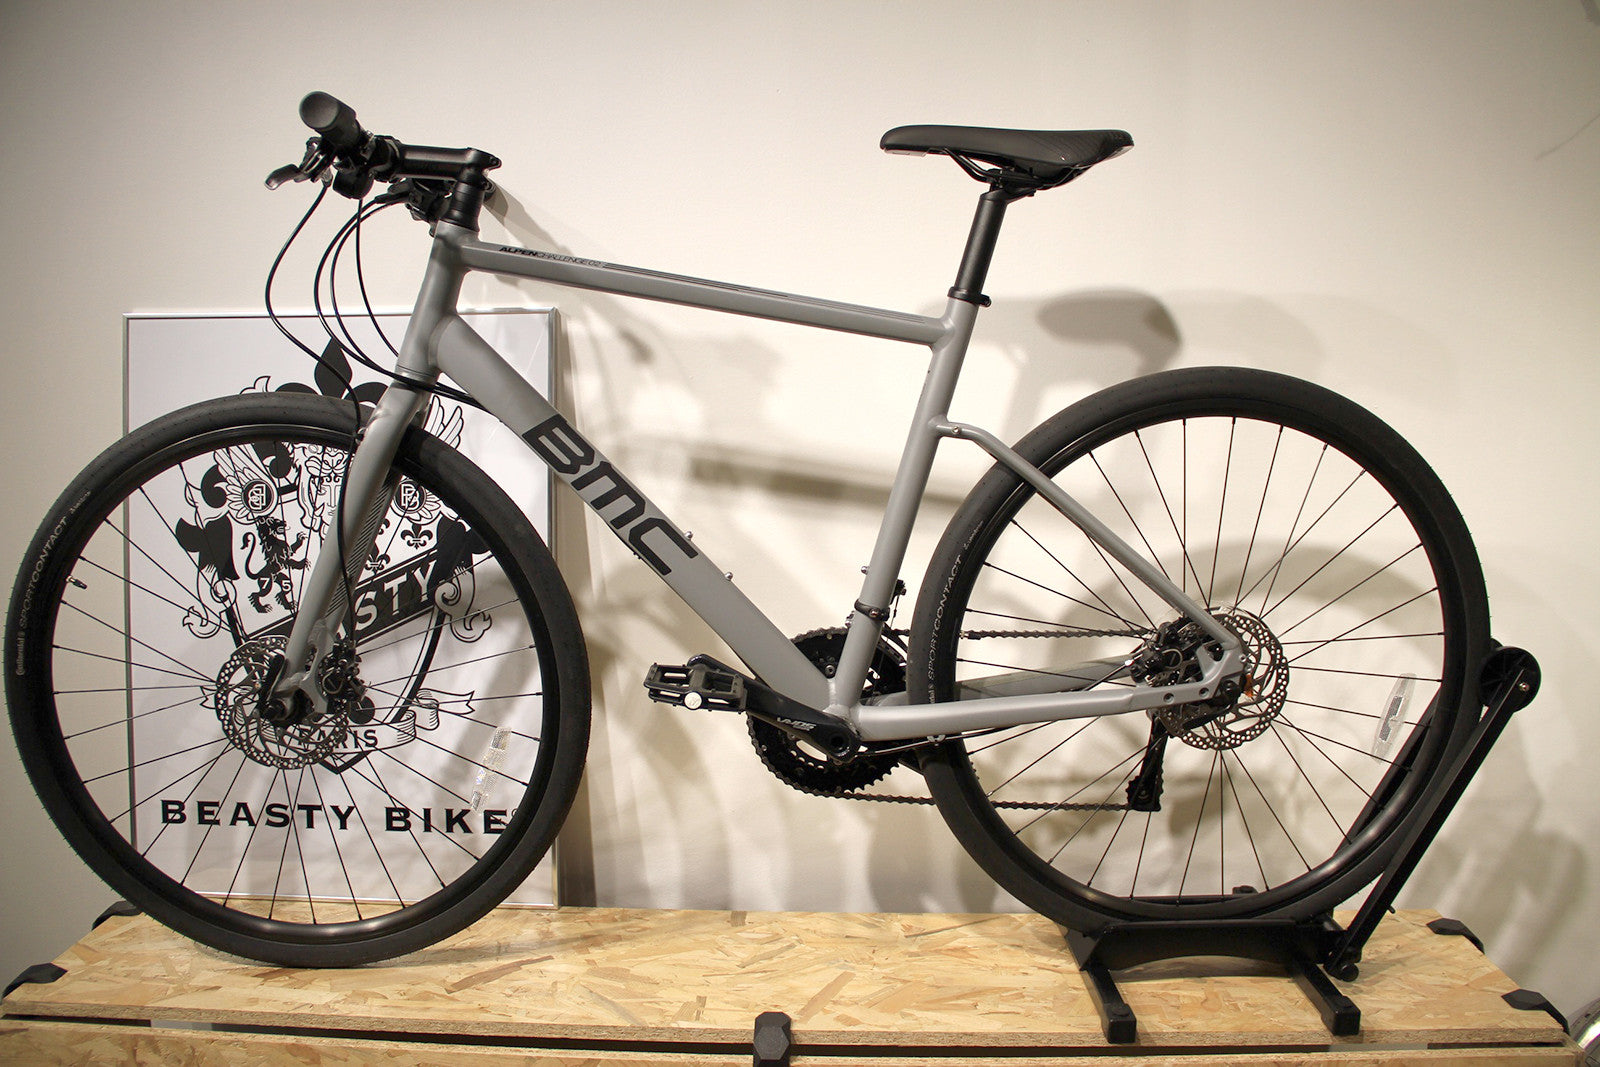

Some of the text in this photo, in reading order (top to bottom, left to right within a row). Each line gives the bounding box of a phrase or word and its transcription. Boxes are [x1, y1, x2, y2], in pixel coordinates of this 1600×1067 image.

[522, 414, 699, 576] BMC
[19, 516, 68, 629] SPORTCONTACT
[337, 558, 437, 638] STY
[927, 554, 962, 681] SPORTCONTACT
[161, 799, 509, 835] BEASTY BIKE
